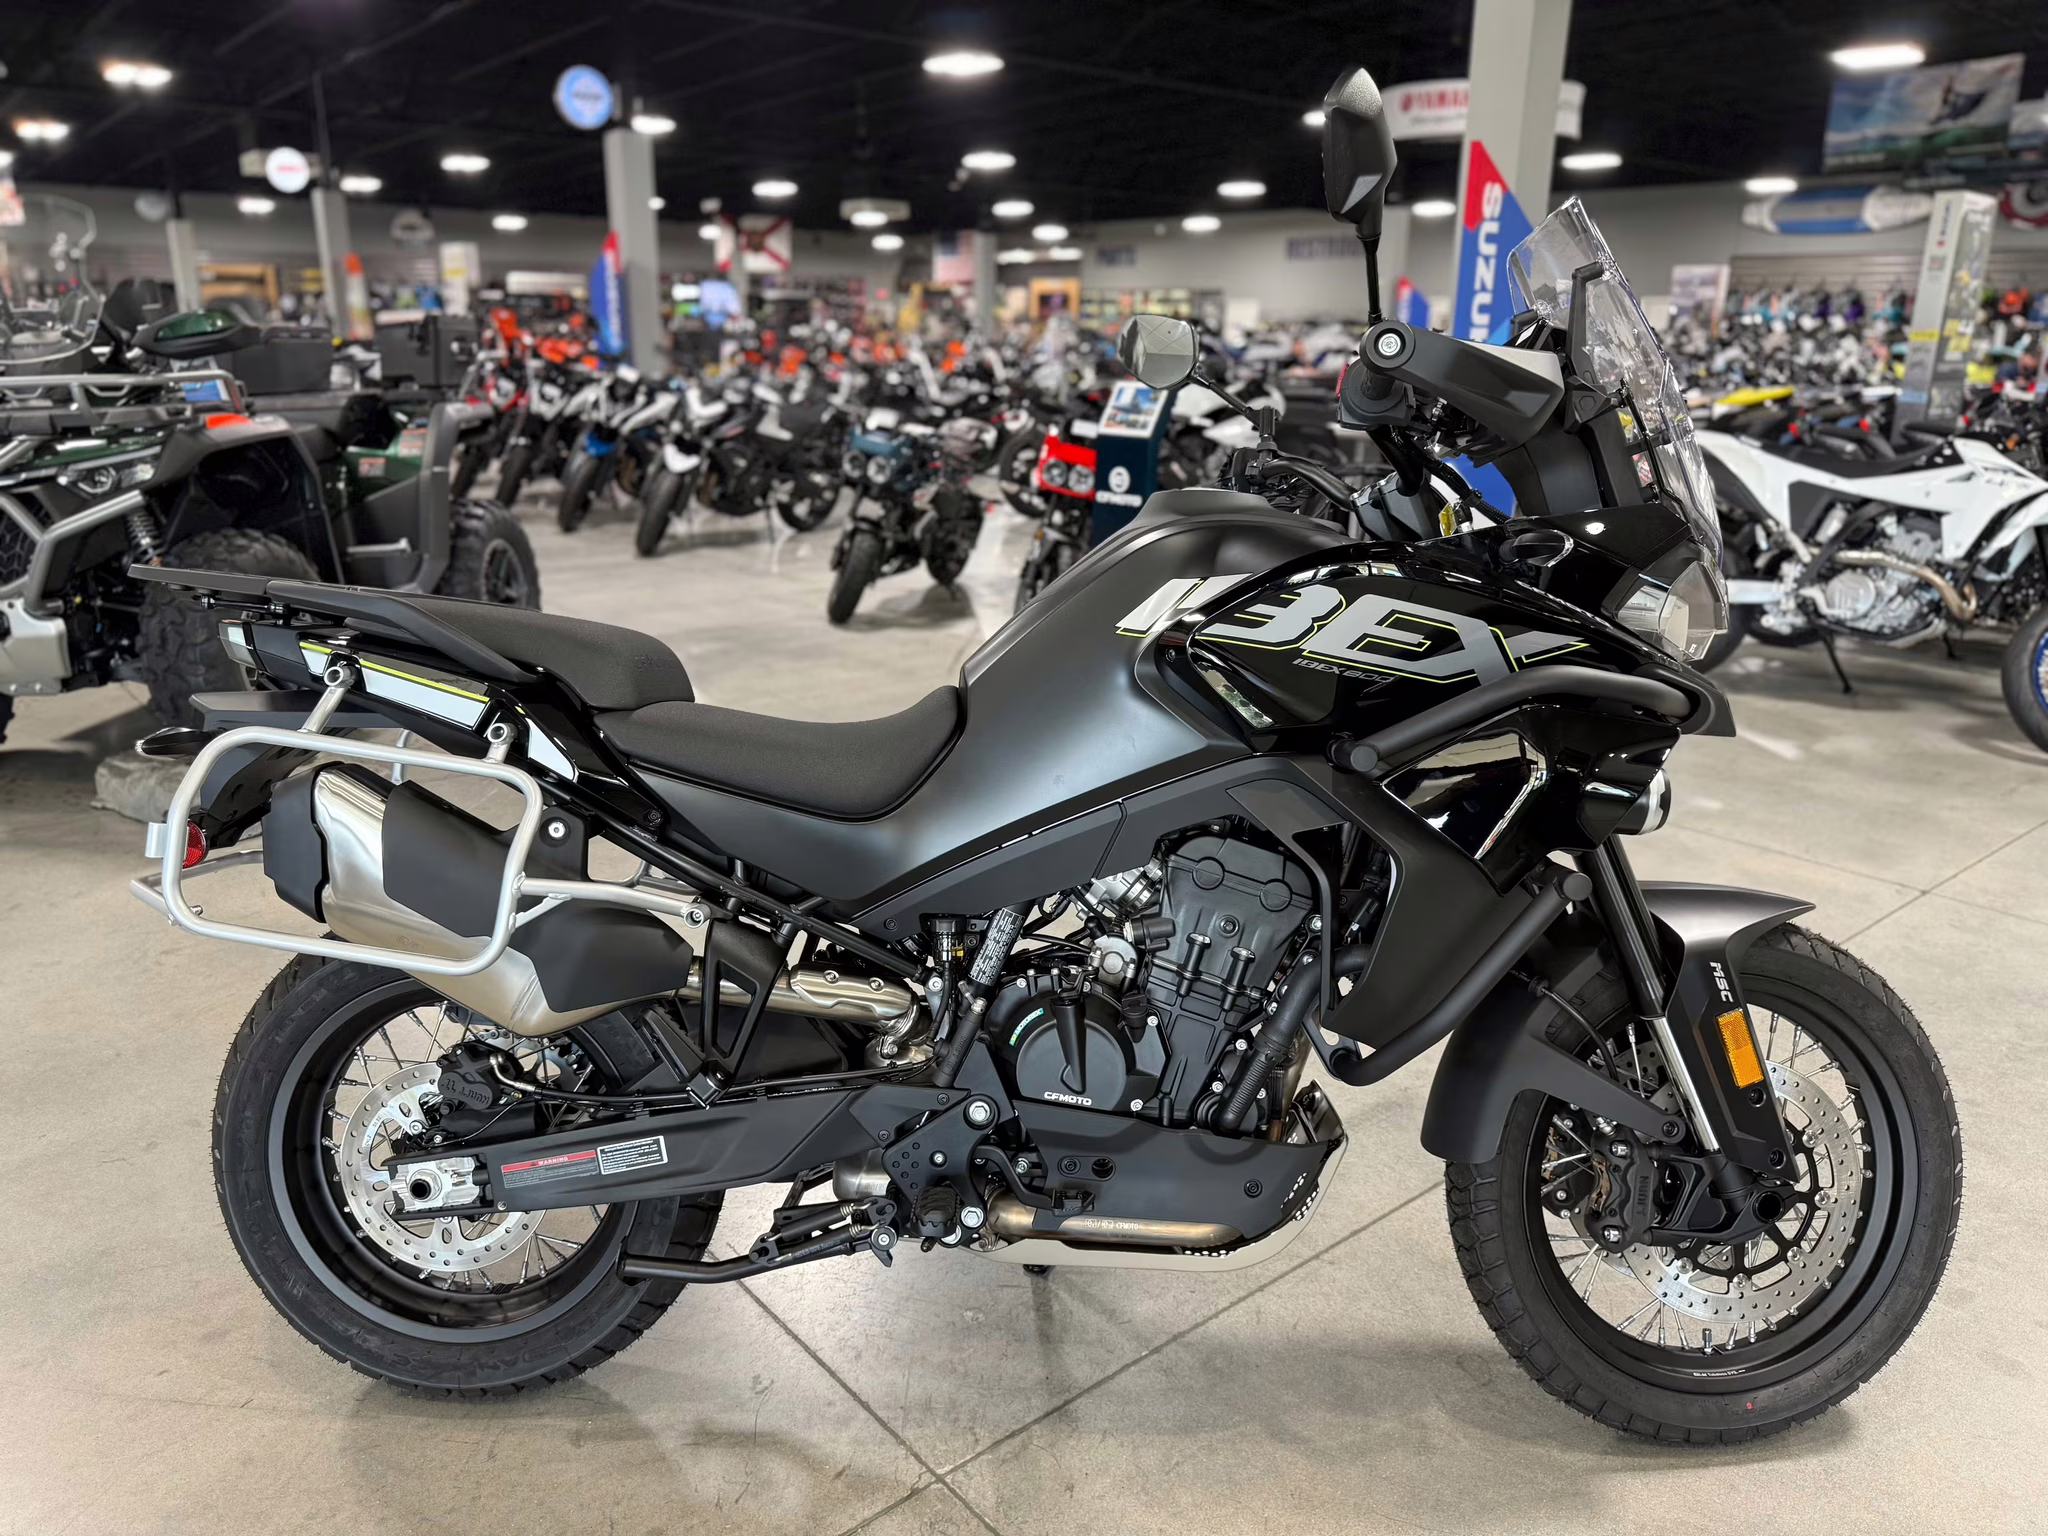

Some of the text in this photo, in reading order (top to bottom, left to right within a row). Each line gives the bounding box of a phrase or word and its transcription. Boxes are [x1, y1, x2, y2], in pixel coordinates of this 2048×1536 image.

[1709, 961, 1734, 1003] MSC
[1043, 1091, 1092, 1106] CFMOTO
[538, 1156, 569, 1165] WARNING
